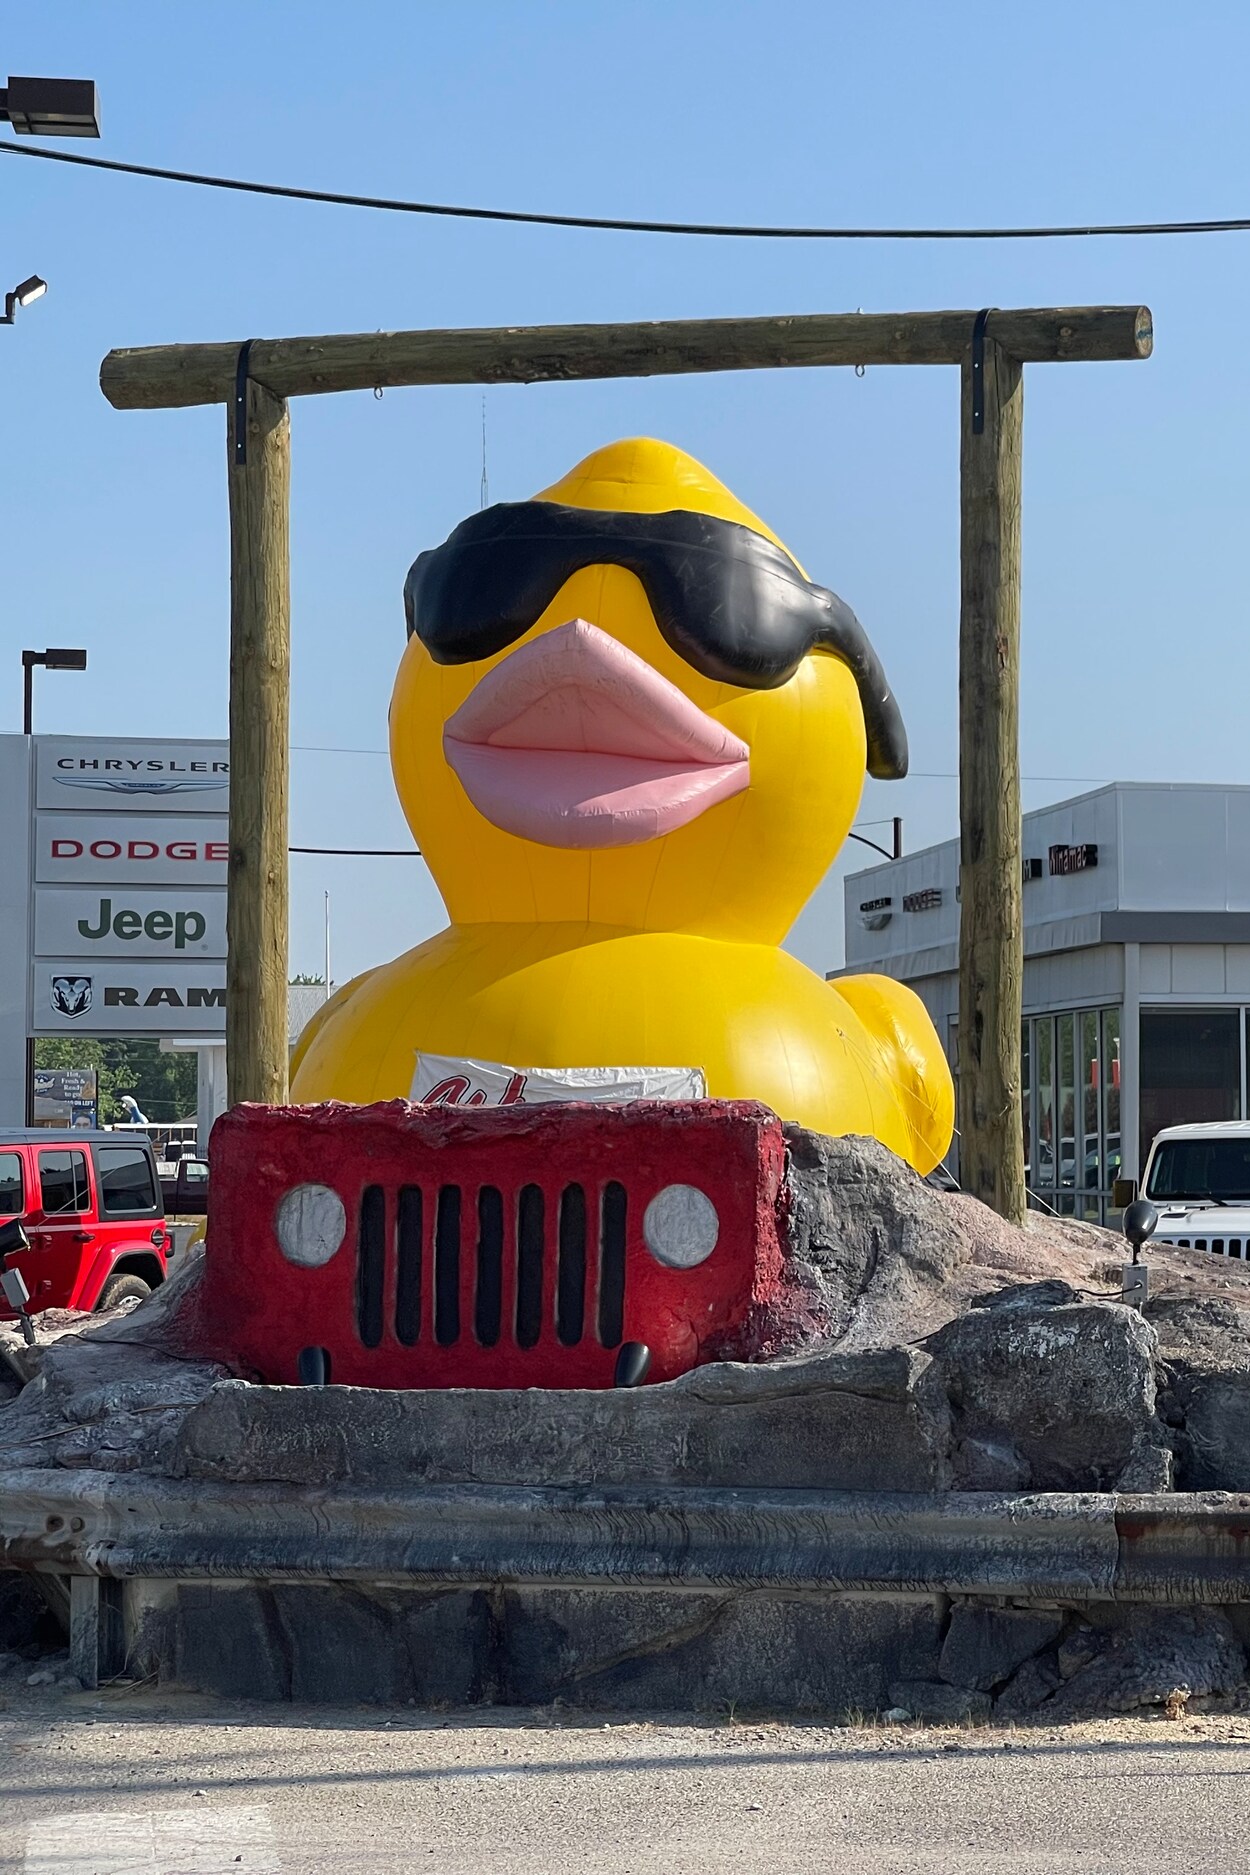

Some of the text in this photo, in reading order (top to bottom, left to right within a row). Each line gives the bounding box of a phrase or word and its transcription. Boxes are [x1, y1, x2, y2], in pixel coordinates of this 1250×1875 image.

[57, 758, 229, 773] CHRYSLER
[51, 840, 229, 860] DODGE
[77, 898, 206, 949] Jeep
[104, 987, 226, 1007] RAM
